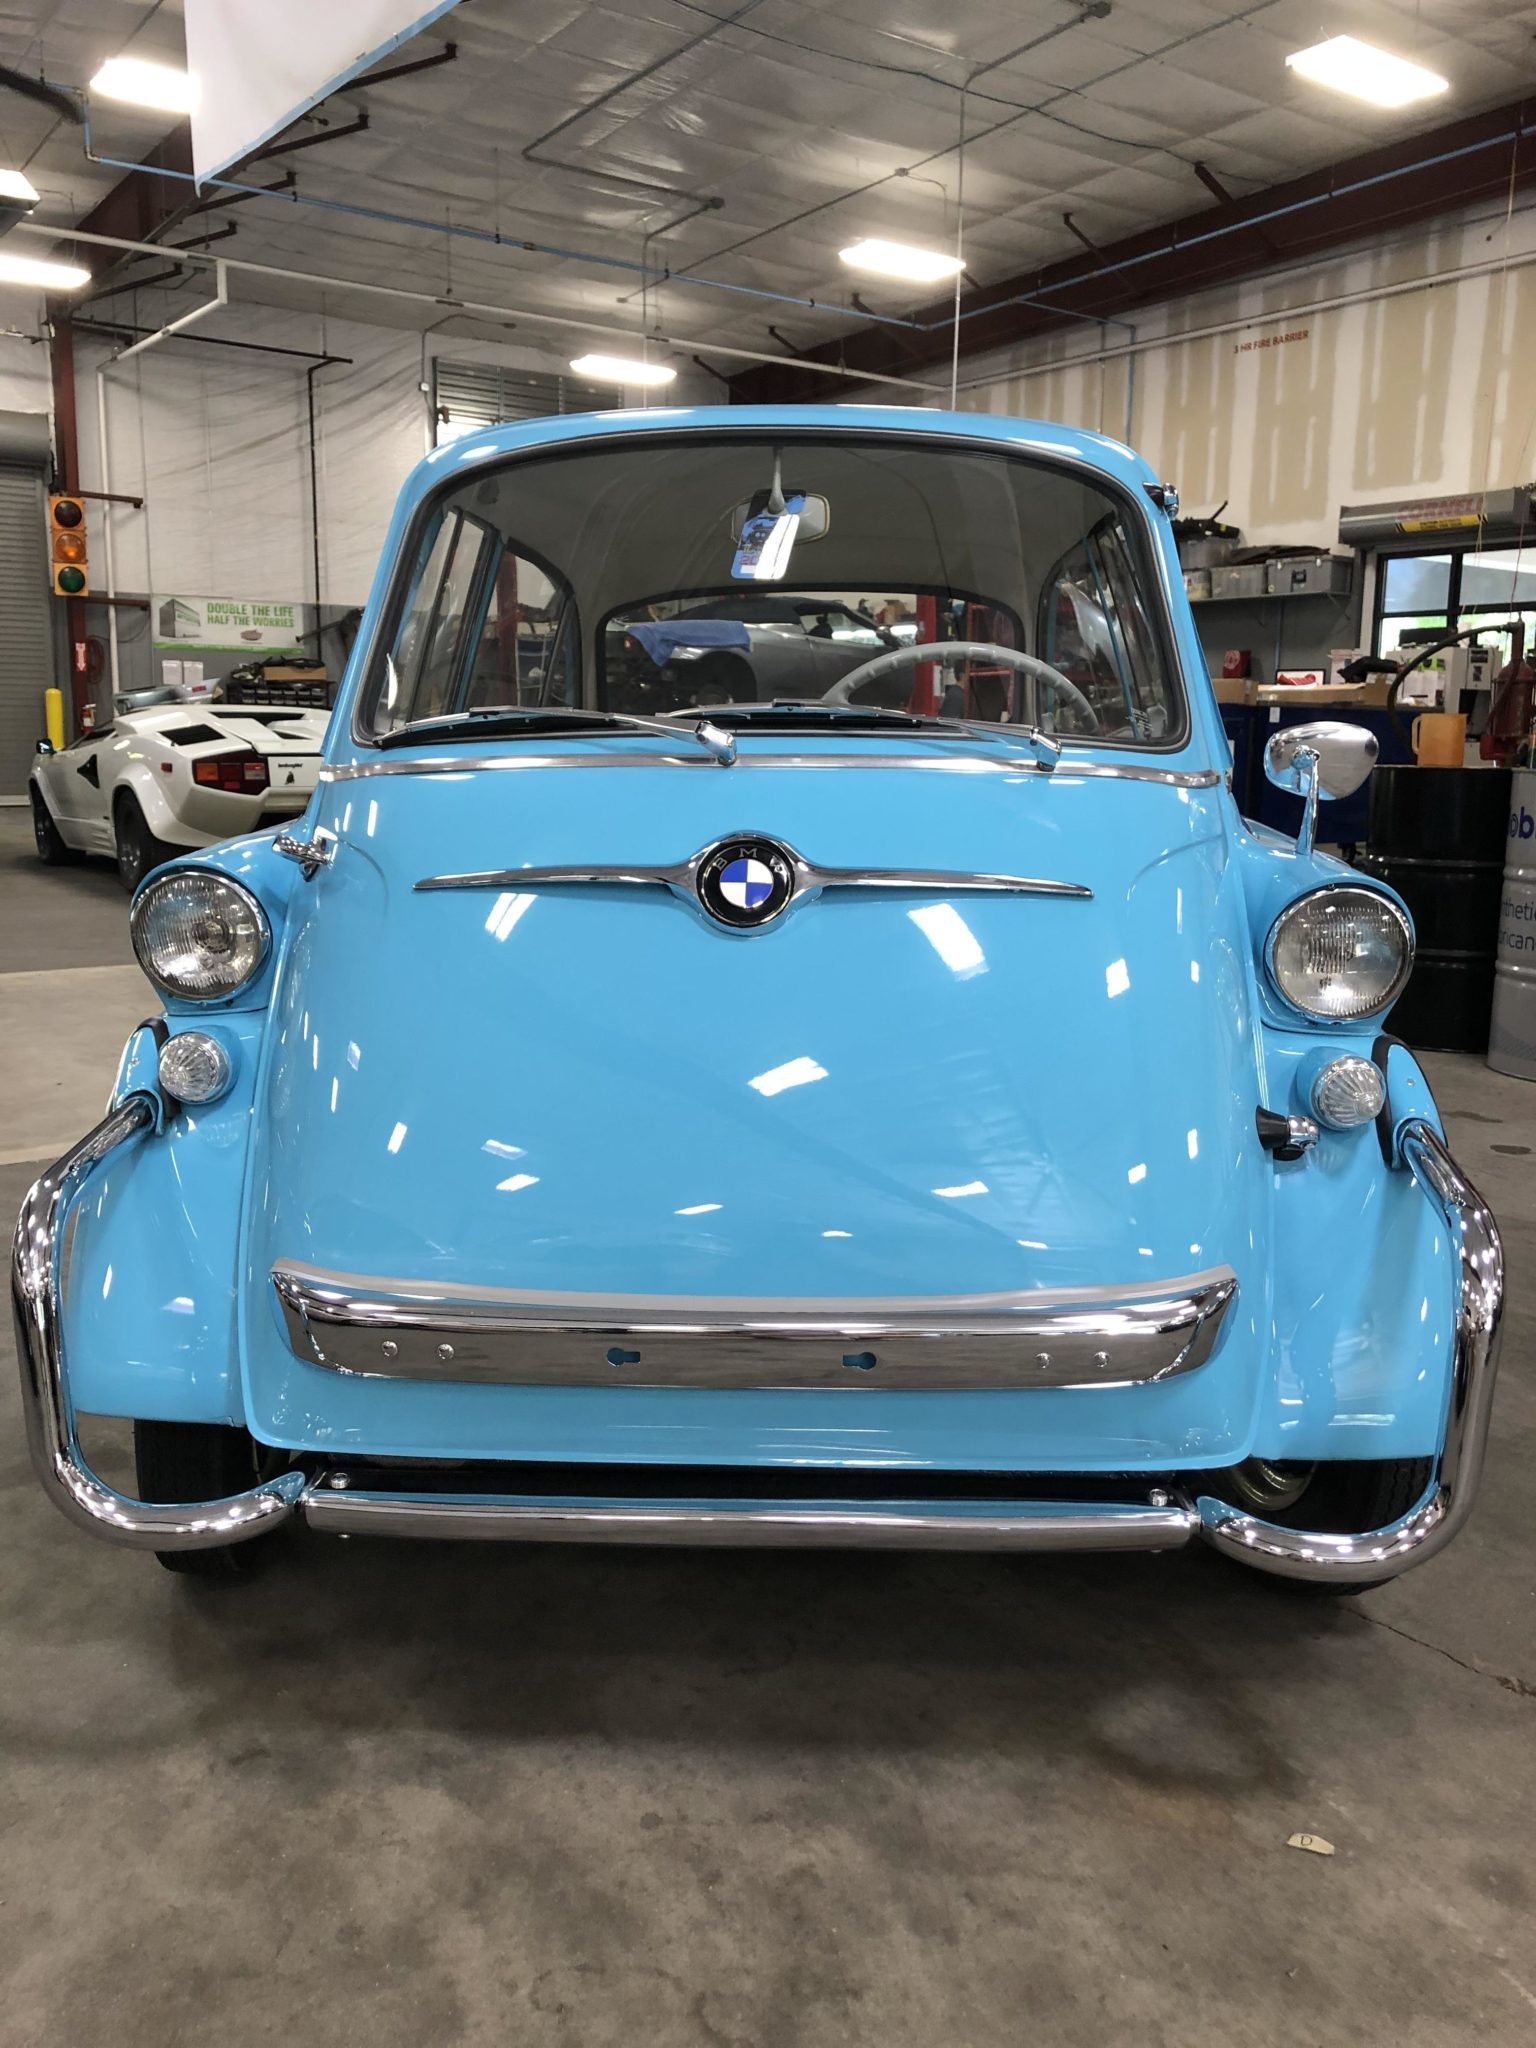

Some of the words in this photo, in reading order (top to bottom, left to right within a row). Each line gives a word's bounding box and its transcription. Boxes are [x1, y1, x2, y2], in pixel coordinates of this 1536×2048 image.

[1240, 341, 1252, 352] HR
[1253, 337, 1270, 348] FIRE
[1273, 330, 1308, 345] BARRIER
[207, 602, 248, 615] DOUBLE
[252, 605, 270, 616] THE
[273, 606, 294, 617] LIFE
[207, 614, 230, 625] HALF
[232, 615, 250, 626] THE
[252, 617, 294, 627] WORRIES
[1509, 806, 1536, 839] ob
